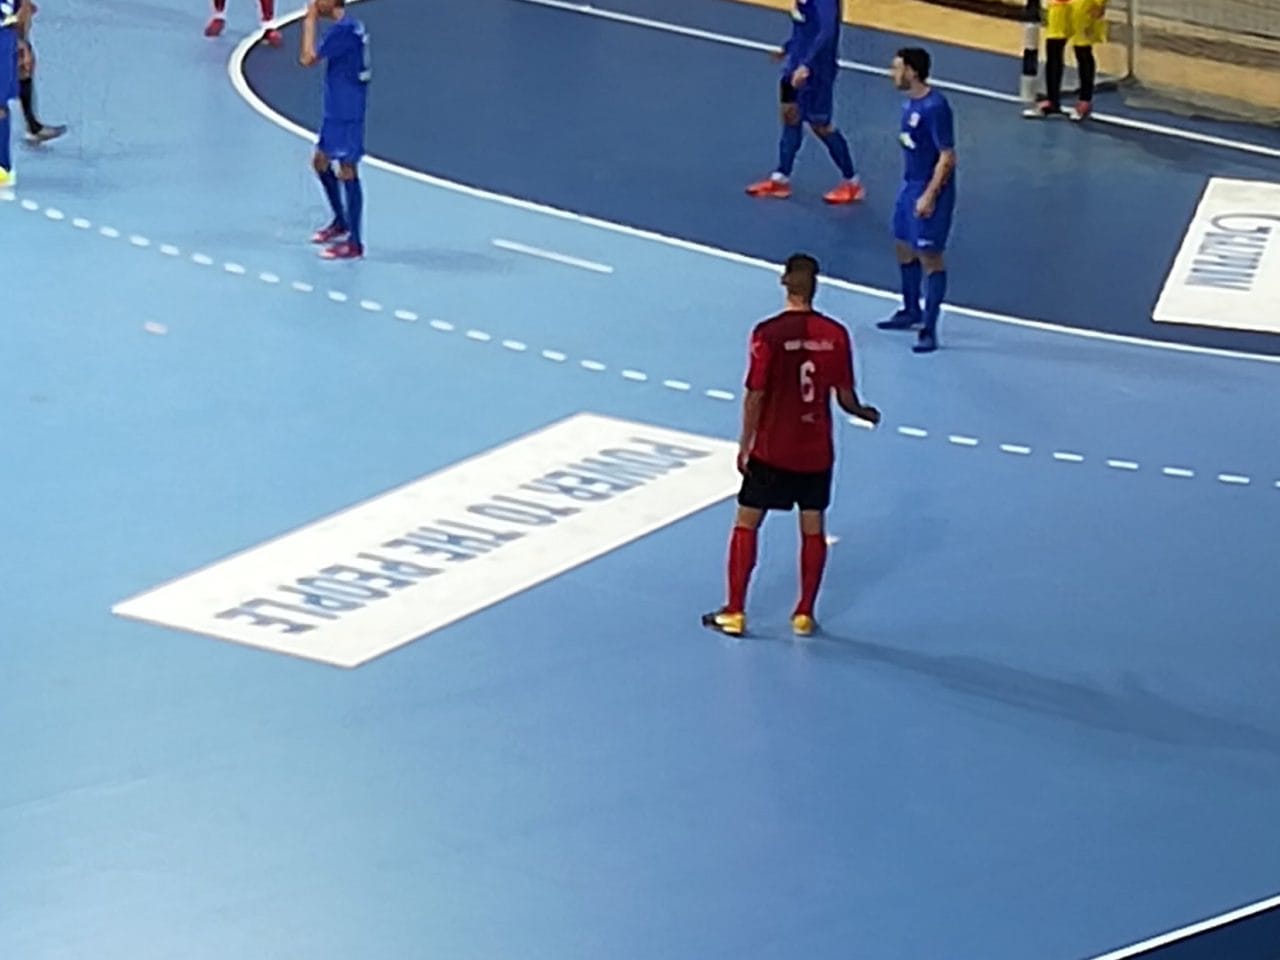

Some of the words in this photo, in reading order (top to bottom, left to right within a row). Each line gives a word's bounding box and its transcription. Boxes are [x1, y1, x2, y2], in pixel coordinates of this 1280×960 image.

[800, 359, 816, 403] 6
[517, 436, 714, 502] POWER
[466, 494, 583, 526] TO
[379, 519, 528, 562] THE
[214, 551, 445, 634] PEOPLE
